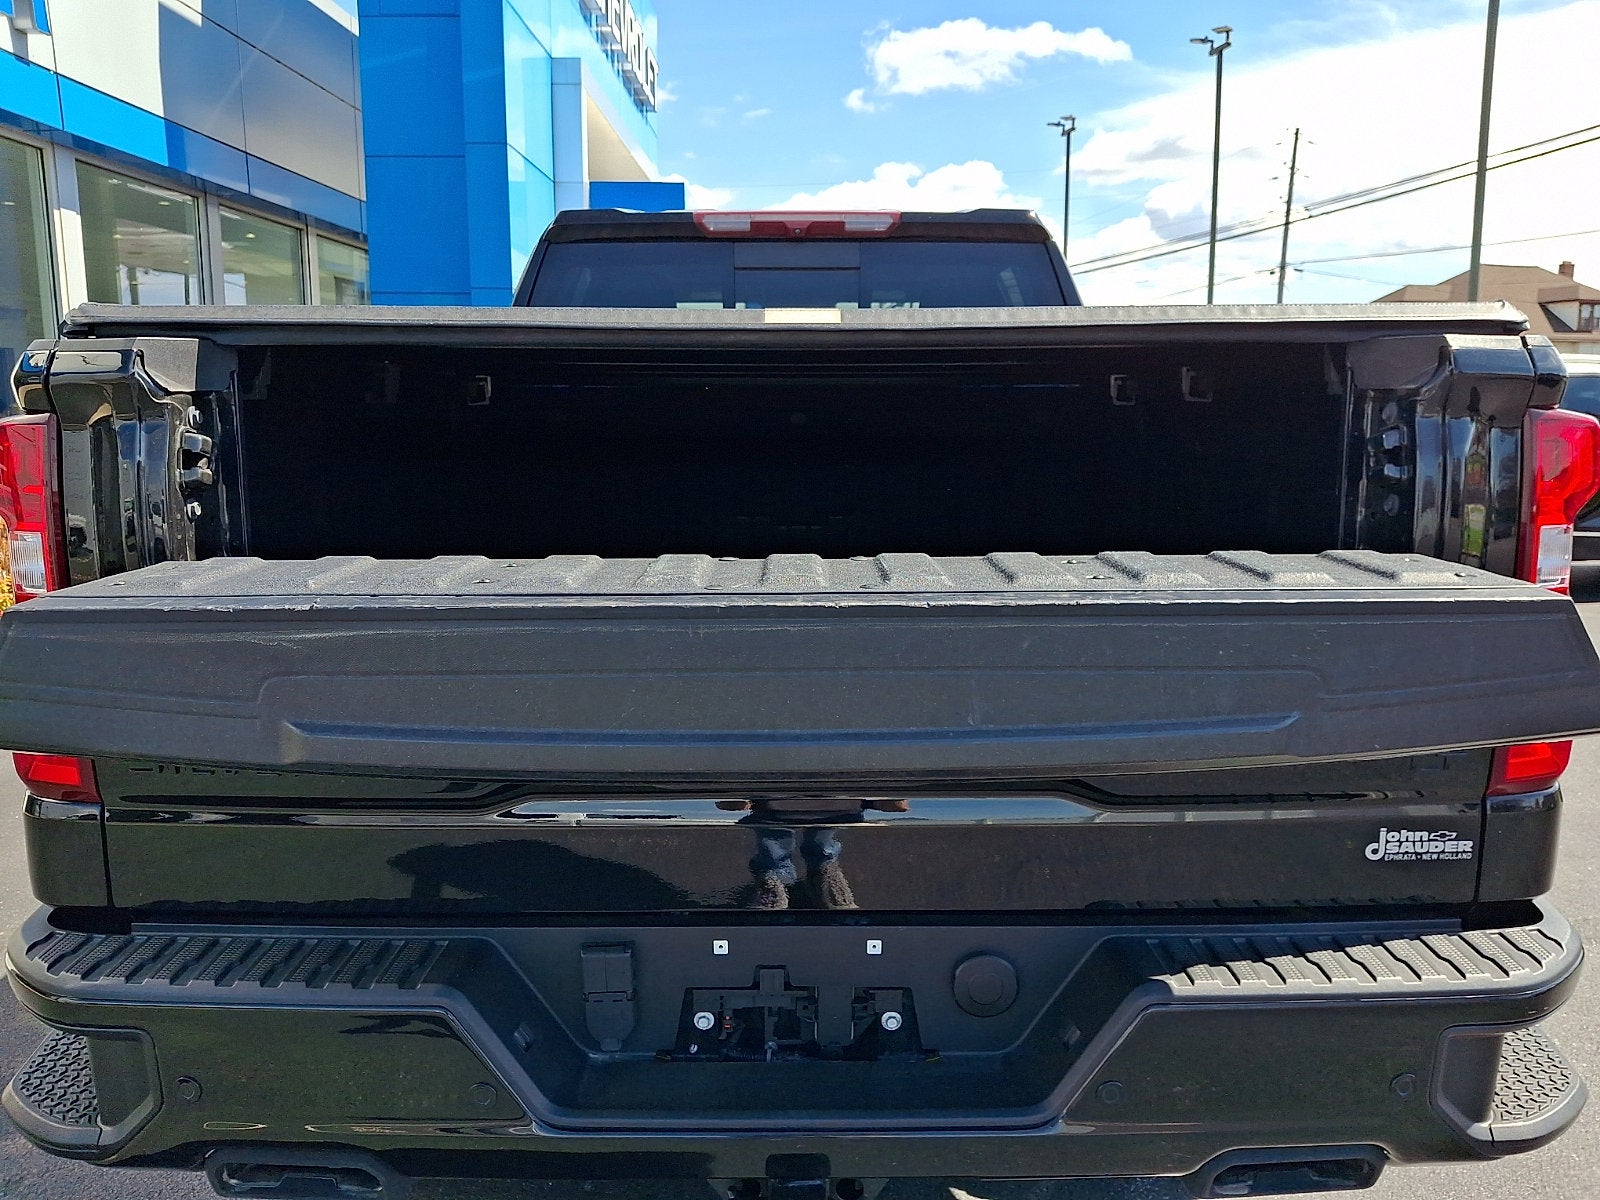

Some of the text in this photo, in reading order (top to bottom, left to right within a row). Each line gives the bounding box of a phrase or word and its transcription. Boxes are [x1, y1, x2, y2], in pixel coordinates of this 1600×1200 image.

[1365, 828, 1429, 860] john
[1386, 841, 1473, 853] SAUDER
[1385, 853, 1416, 861] EPHRATA
[1439, 852, 1473, 860] HOLLAND
